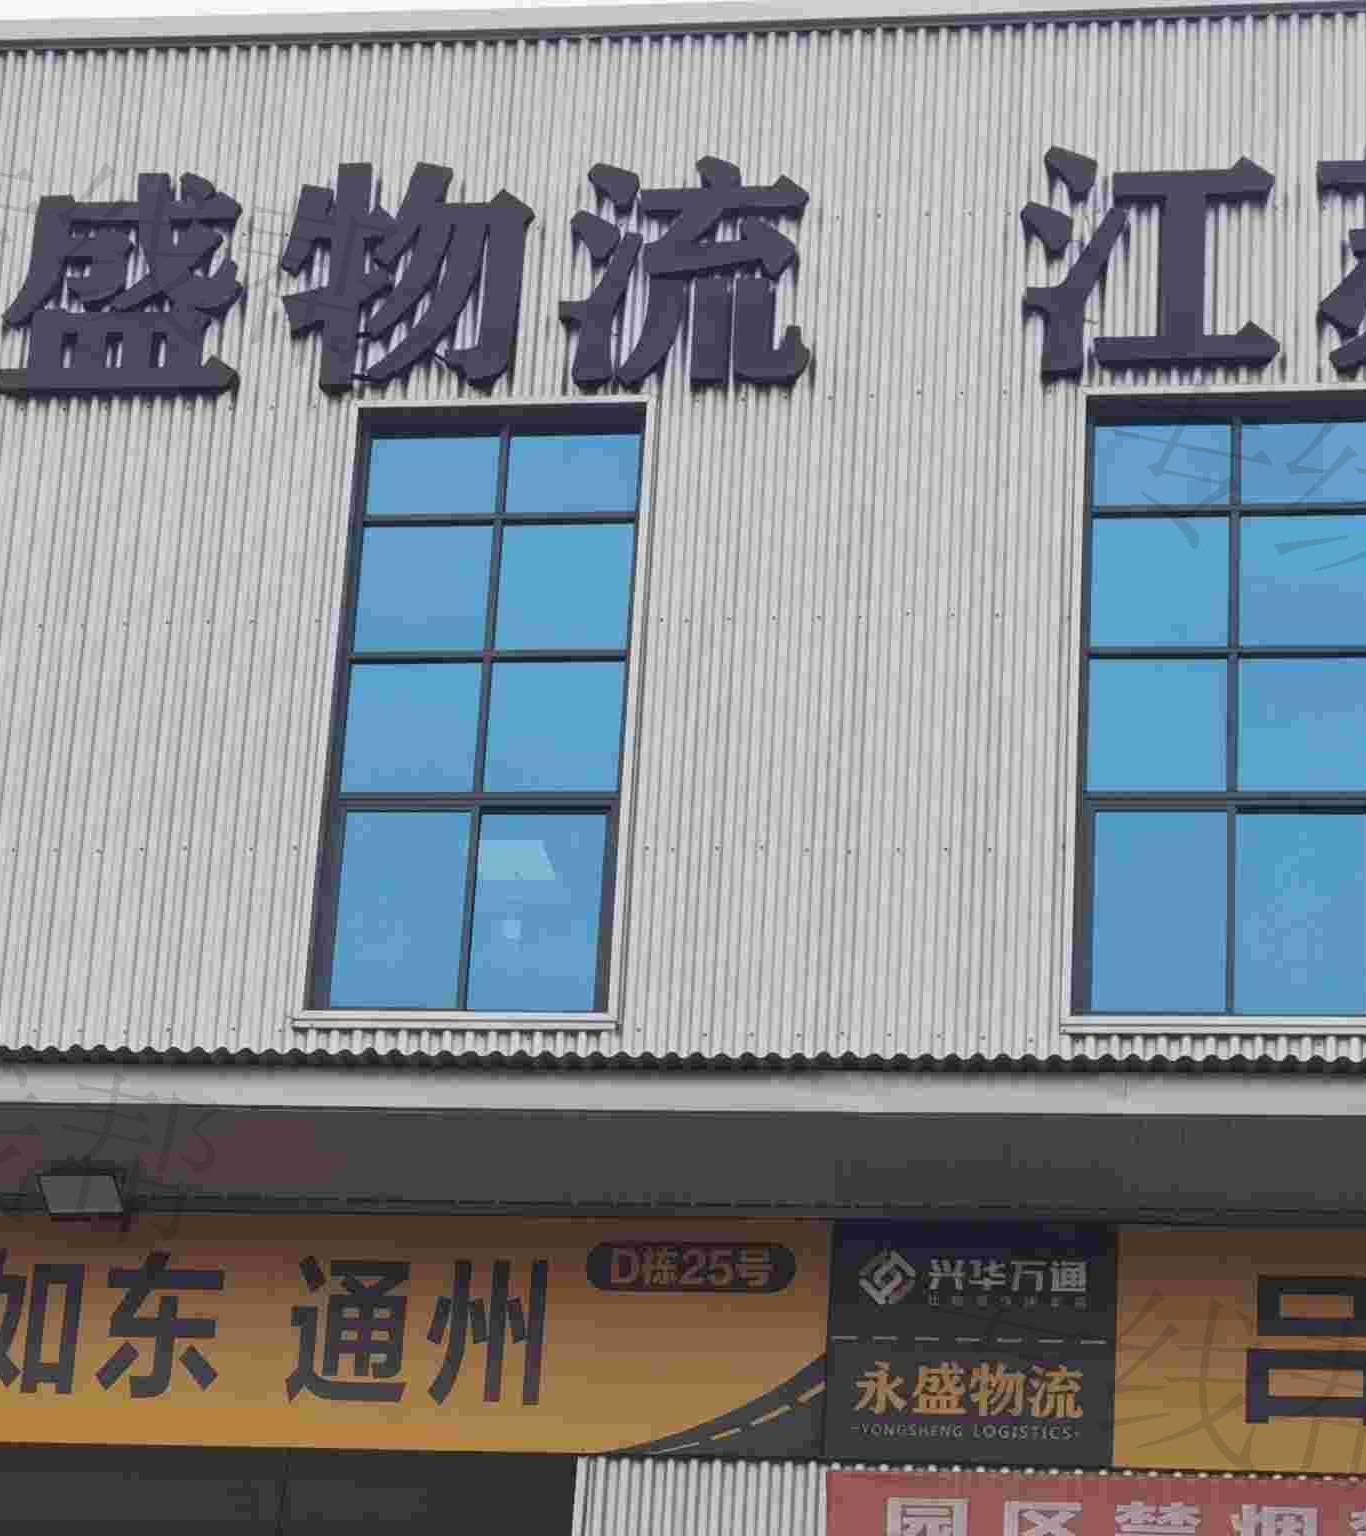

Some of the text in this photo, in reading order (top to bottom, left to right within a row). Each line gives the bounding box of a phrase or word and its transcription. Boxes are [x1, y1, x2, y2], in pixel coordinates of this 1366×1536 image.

[609, 1244, 774, 1288] D栋25号
[928, 1257, 1089, 1294] 兴华万通
[286, 1255, 549, 1406] 通州
[853, 1360, 1084, 1421] 永盛物流
